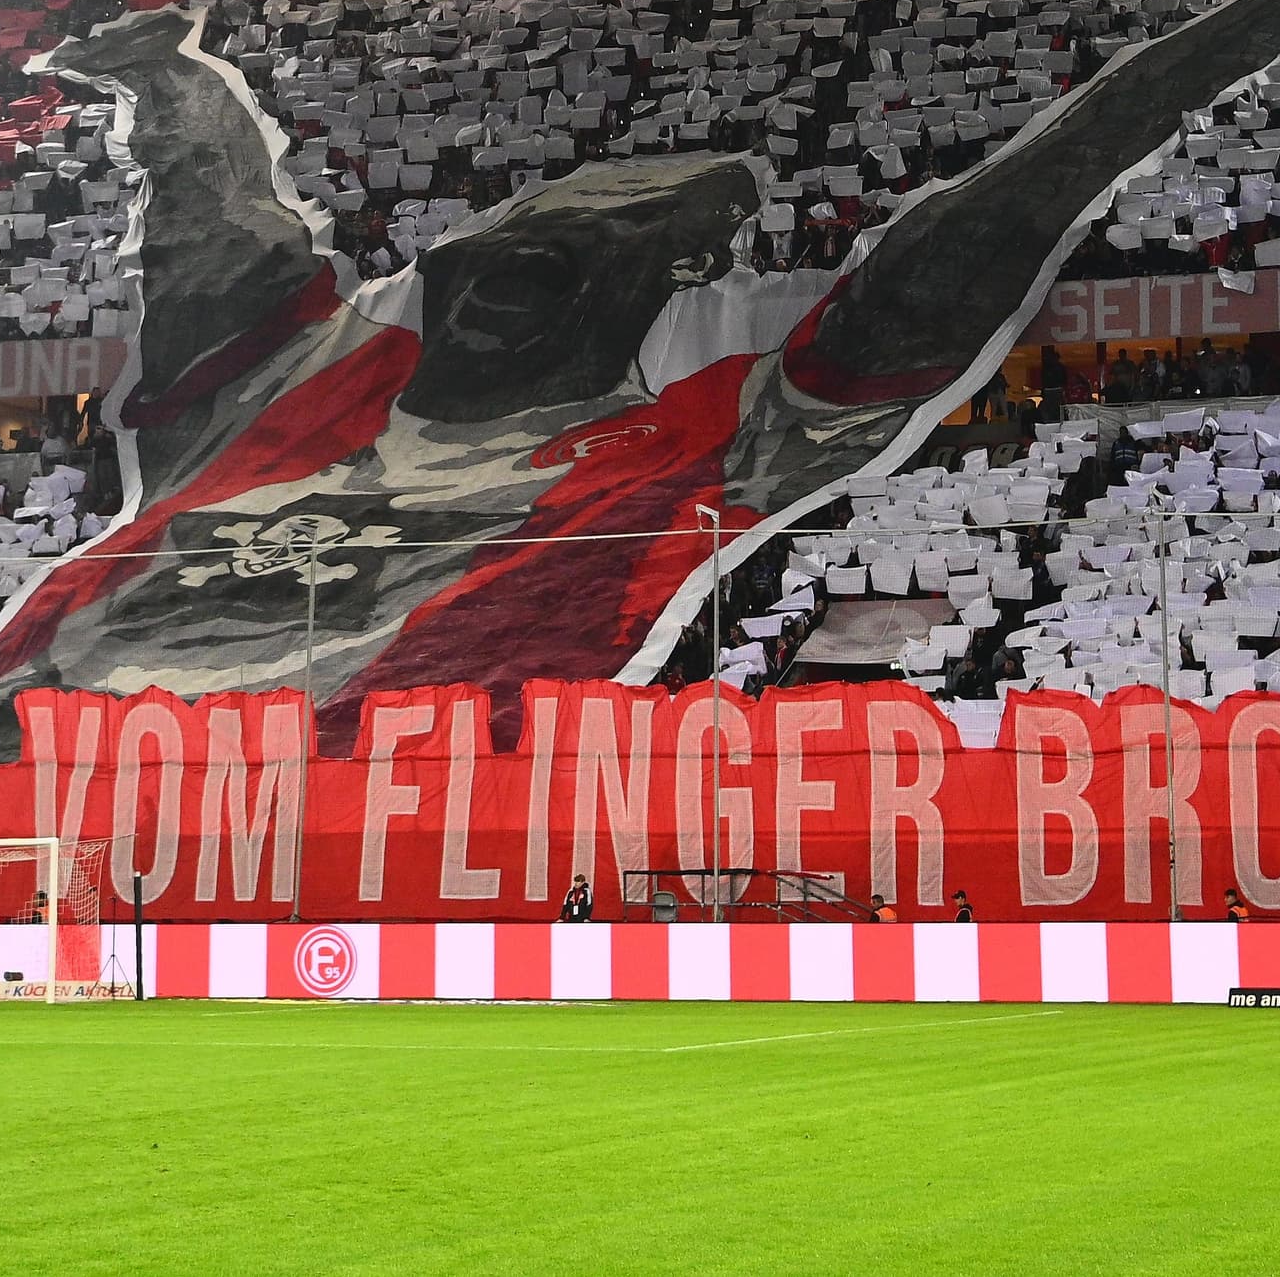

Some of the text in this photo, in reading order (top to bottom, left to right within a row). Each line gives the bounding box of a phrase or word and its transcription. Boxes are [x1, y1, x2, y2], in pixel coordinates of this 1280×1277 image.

[1051, 273, 1240, 341] SEITE
[27, 702, 301, 905] VOM
[359, 696, 945, 904] FLINGER
[75, 985, 136, 998] AKTUELL
[1230, 994, 1255, 1007] me
